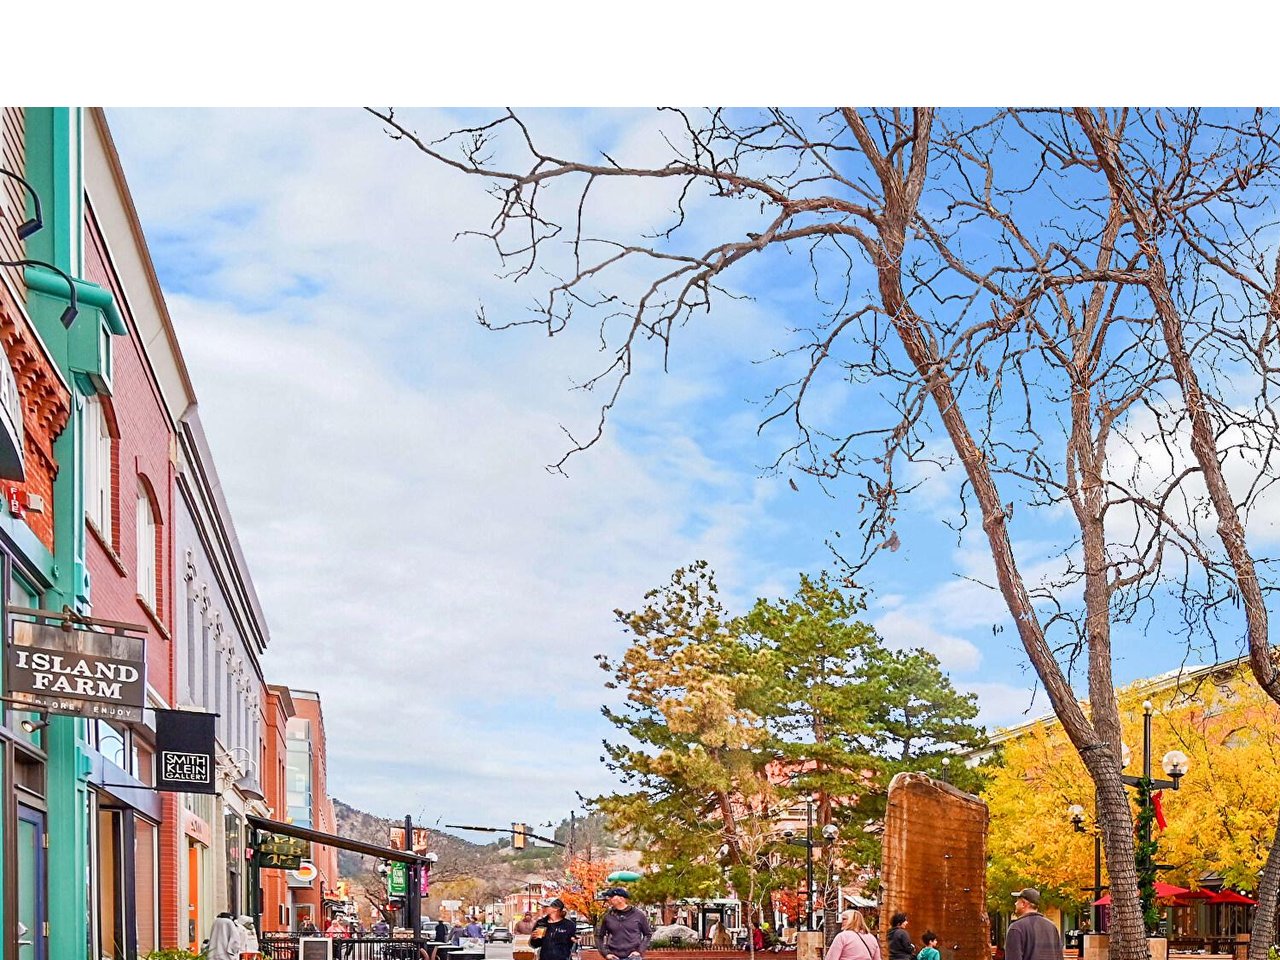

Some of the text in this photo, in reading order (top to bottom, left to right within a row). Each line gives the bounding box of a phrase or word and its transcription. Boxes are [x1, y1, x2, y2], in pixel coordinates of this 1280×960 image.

[10, 487, 20, 513] FIRE
[16, 650, 139, 683] ISLAND
[32, 672, 122, 699] FARM
[166, 754, 206, 766] SMITH
[167, 764, 206, 775] KLEIN
[165, 772, 206, 780] GALLERY
